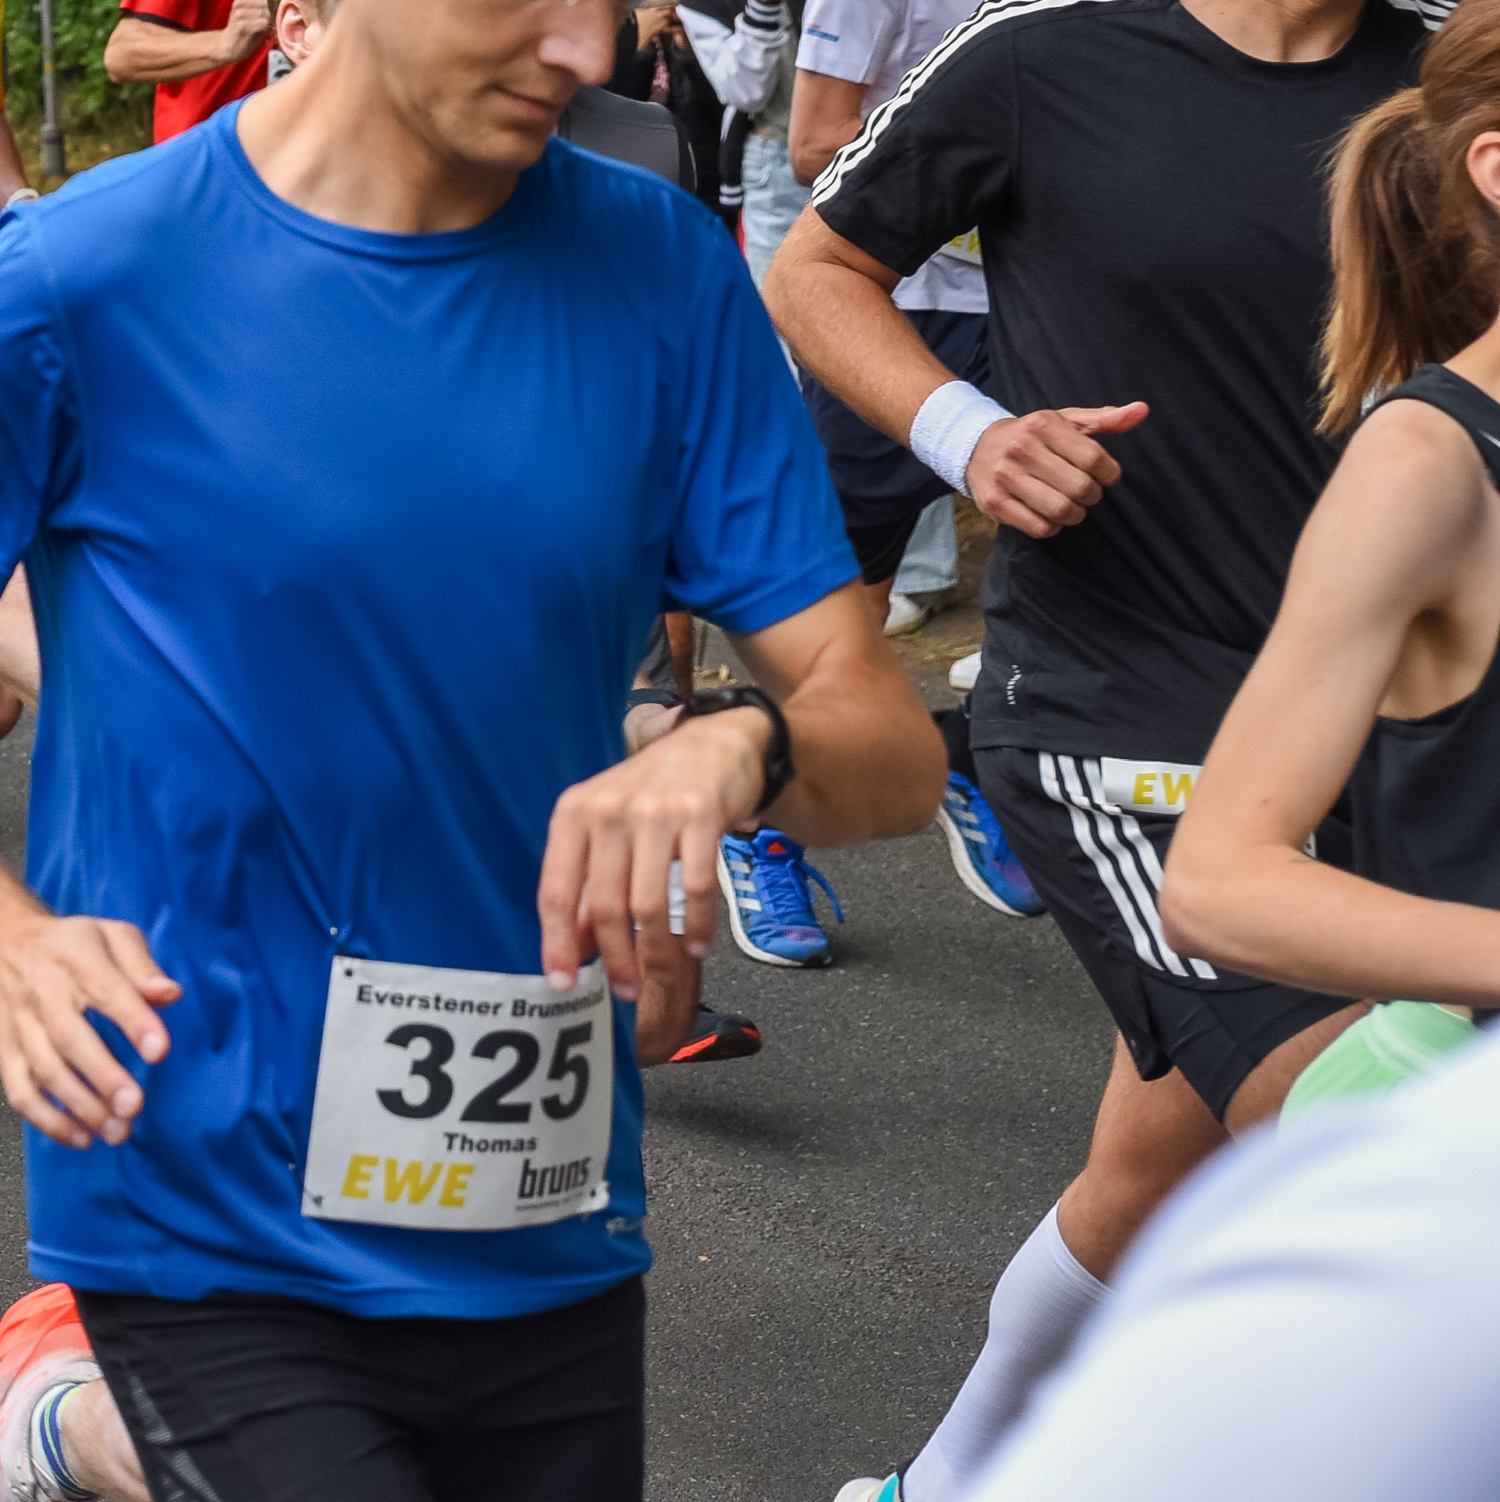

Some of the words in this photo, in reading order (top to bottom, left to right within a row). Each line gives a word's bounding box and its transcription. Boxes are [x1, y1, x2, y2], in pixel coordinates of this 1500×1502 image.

[1132, 772, 1197, 806] EW
[355, 984, 501, 1017] Everstener
[375, 1020, 594, 1124] 325
[442, 1130, 538, 1155] Thomas
[340, 1153, 476, 1208] EWE
[516, 1156, 592, 1200] bruns
